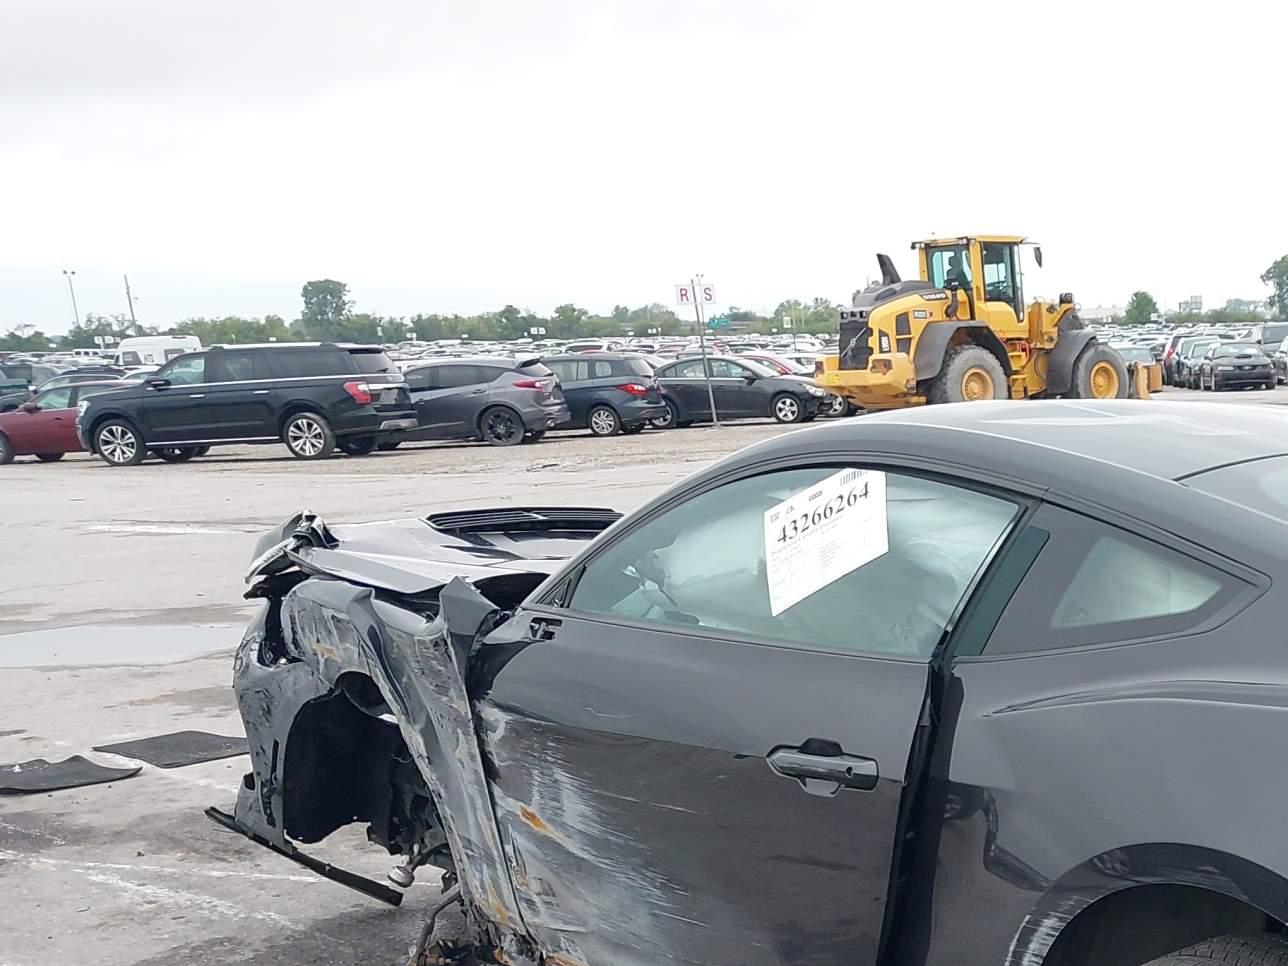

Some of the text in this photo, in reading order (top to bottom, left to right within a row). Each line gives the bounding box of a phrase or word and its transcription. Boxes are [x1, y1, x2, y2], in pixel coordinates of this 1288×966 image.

[679, 287, 690, 302] R
[703, 287, 713, 302] S
[777, 481, 870, 544] 43266264
